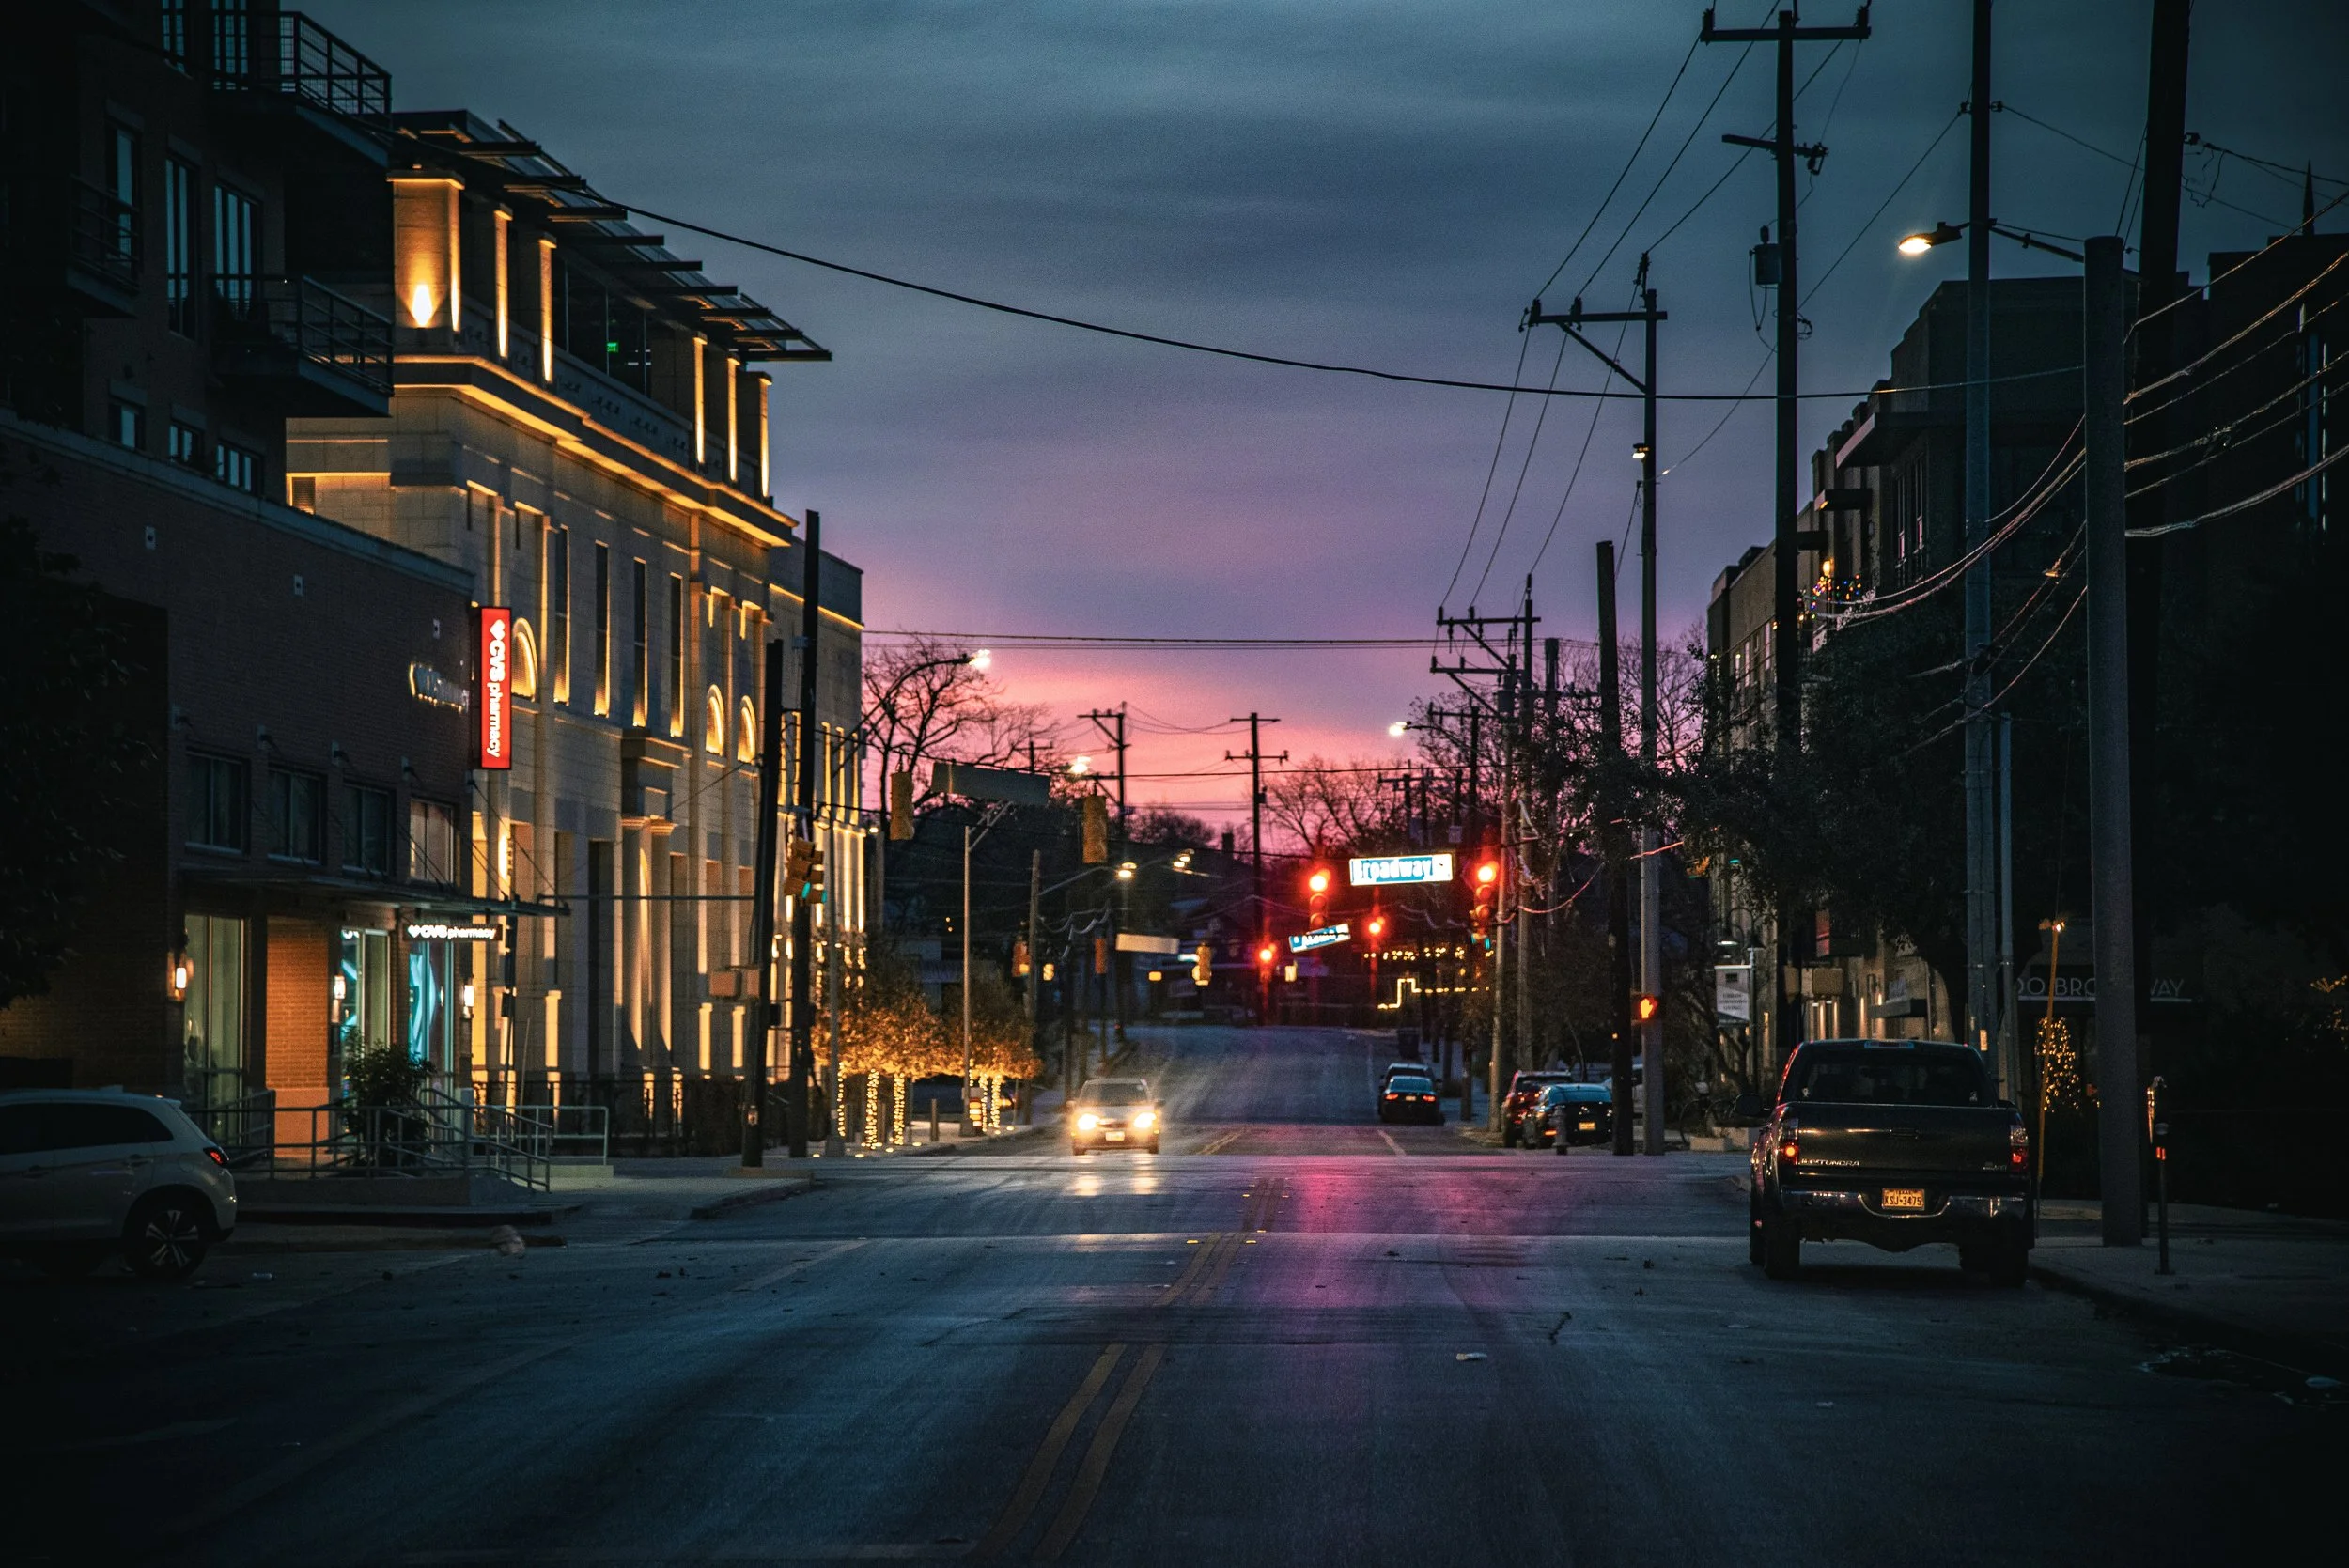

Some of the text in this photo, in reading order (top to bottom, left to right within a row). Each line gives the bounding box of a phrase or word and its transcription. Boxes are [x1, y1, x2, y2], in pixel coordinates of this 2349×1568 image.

[487, 641, 506, 757] CVS pharmacy
[1353, 859, 1432, 881] Broadway
[421, 924, 496, 940] CVS pharmacy
